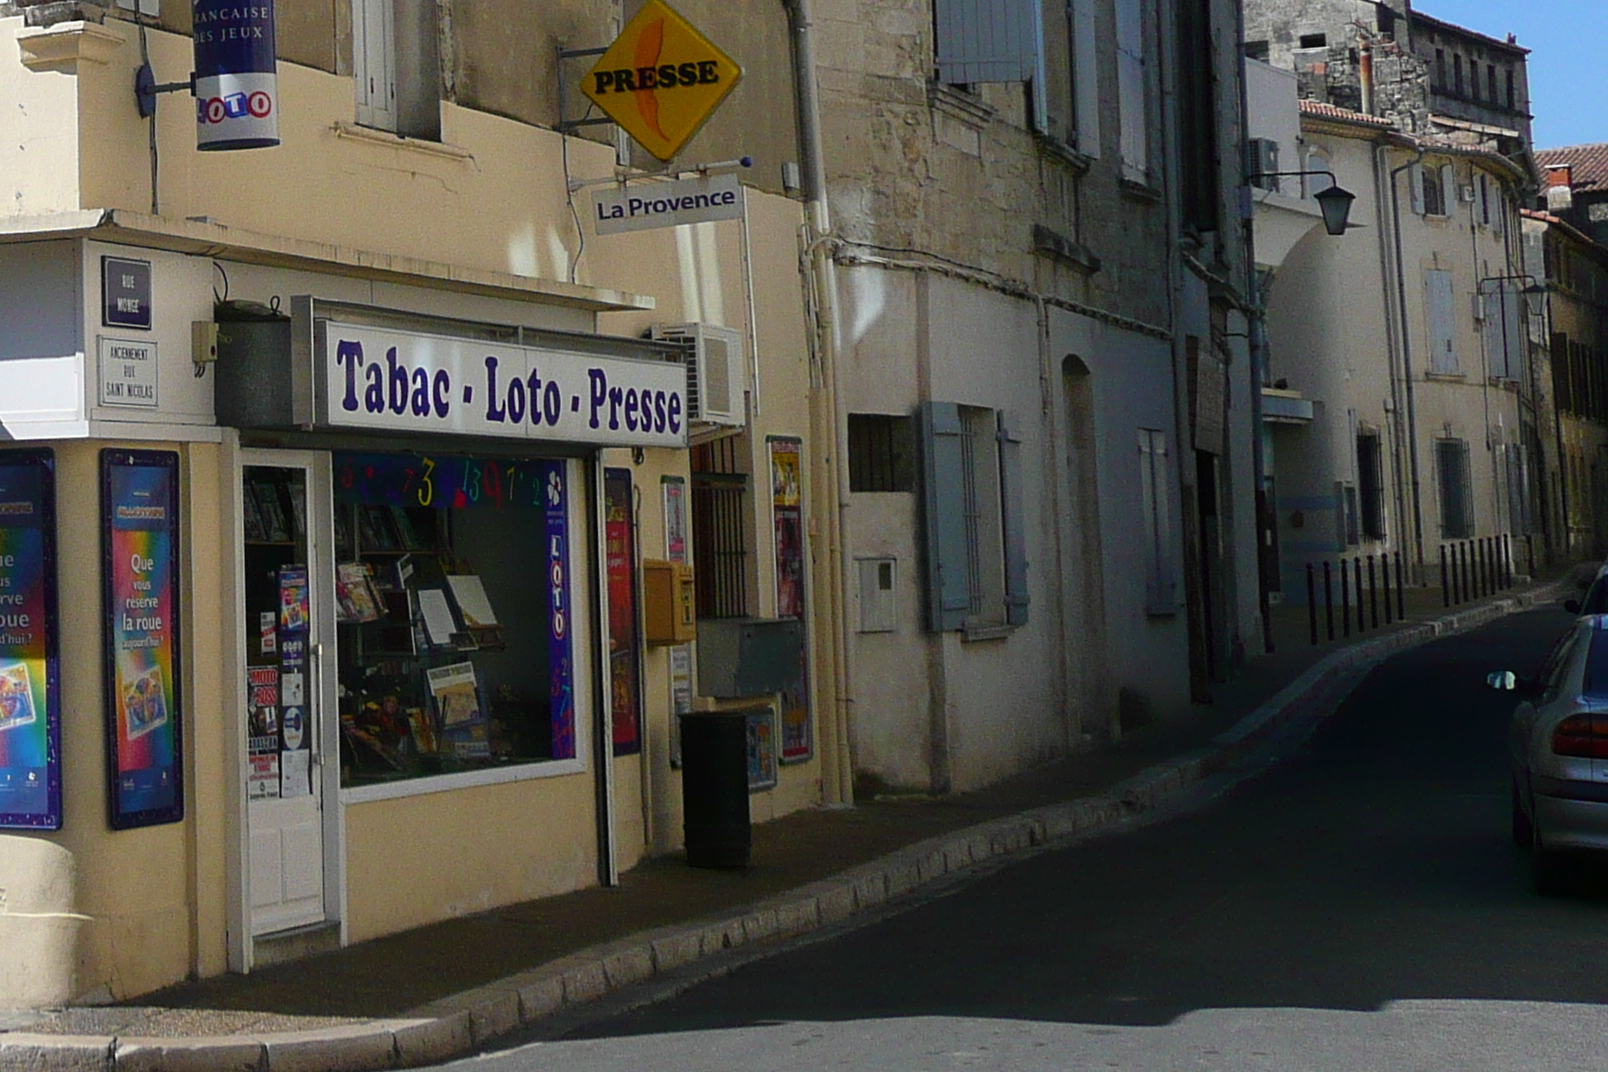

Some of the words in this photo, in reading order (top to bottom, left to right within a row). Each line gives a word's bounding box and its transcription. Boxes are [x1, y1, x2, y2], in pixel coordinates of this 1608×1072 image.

[221, 26, 263, 41] JEUX
[594, 60, 719, 95] PRESSE
[597, 202, 624, 220] La
[628, 191, 735, 217] Provence
[121, 274, 135, 289] RUE
[117, 297, 140, 313] MONGE
[110, 346, 148, 361] ANCIENNEMENT
[123, 365, 136, 378] RUE
[106, 382, 124, 397] SAINT
[127, 383, 153, 399] NICOLAS
[336, 338, 450, 419] Tabac
[484, 356, 561, 426] Loto
[588, 368, 681, 434] Presse
[131, 554, 154, 574] Que
[133, 580, 151, 591] vous
[126, 595, 159, 609] réserve
[122, 613, 133, 631] la
[136, 616, 162, 631] roue
